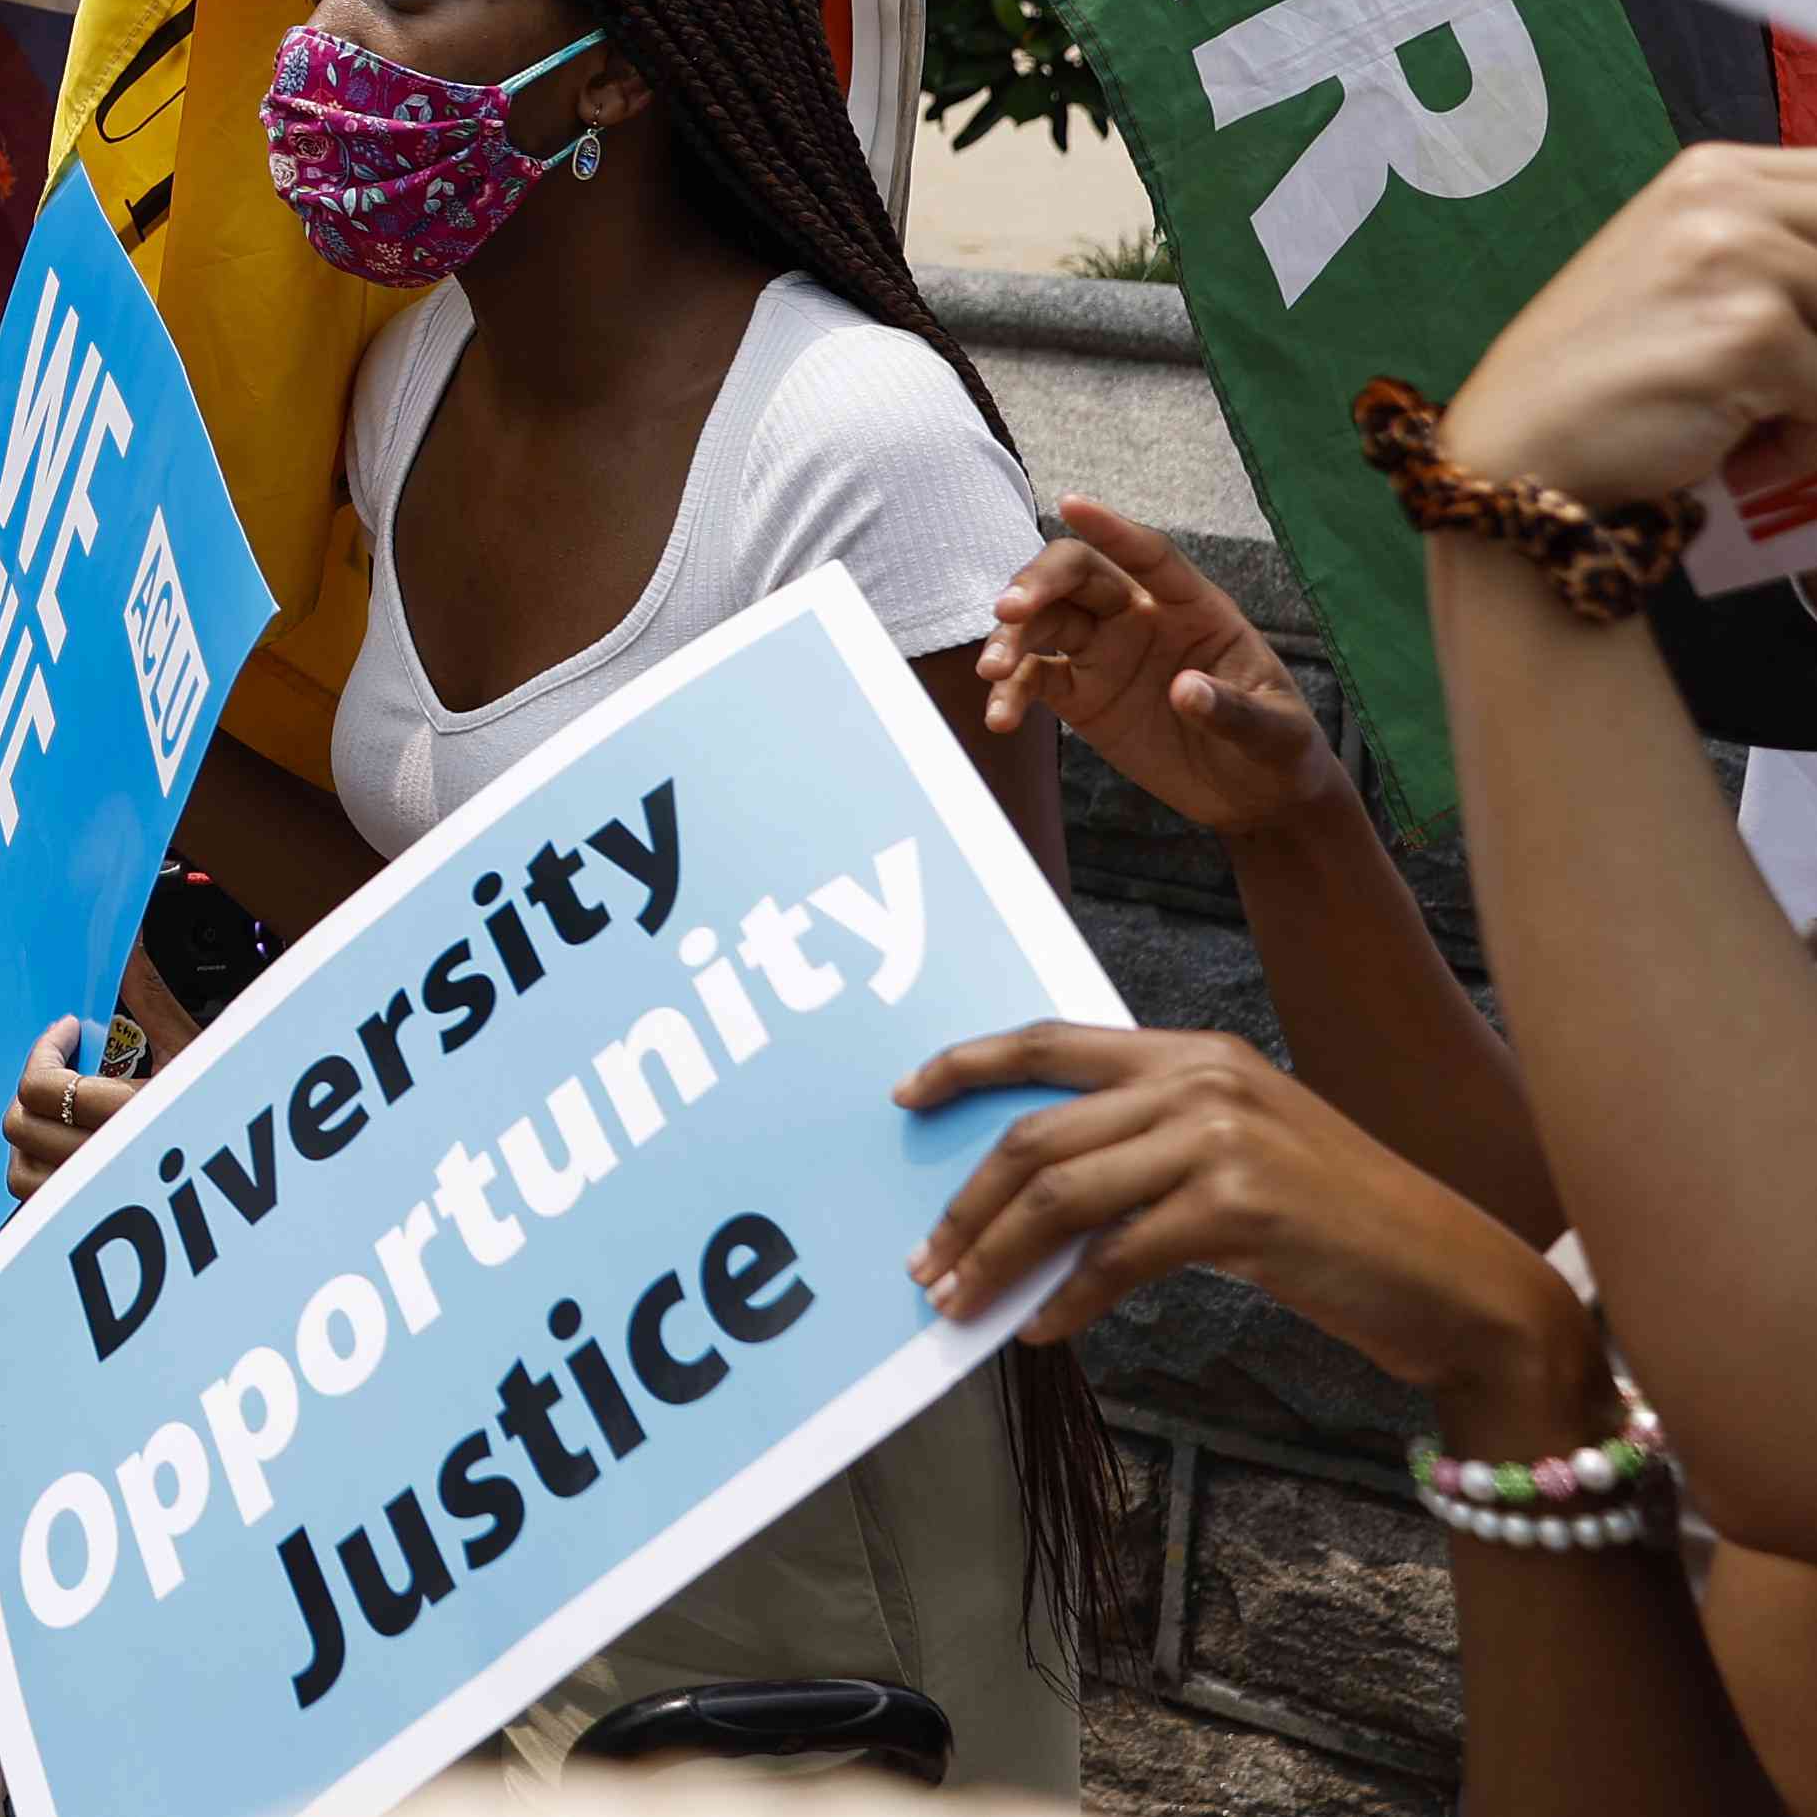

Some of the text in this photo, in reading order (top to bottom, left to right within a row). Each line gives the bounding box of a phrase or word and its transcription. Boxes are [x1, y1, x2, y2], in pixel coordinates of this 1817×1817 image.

[130, 538, 201, 763] ACLU
[17, 837, 931, 1630] Opportunity
[66, 778, 680, 1362] Diversity
[275, 1210, 816, 1710] Justice
